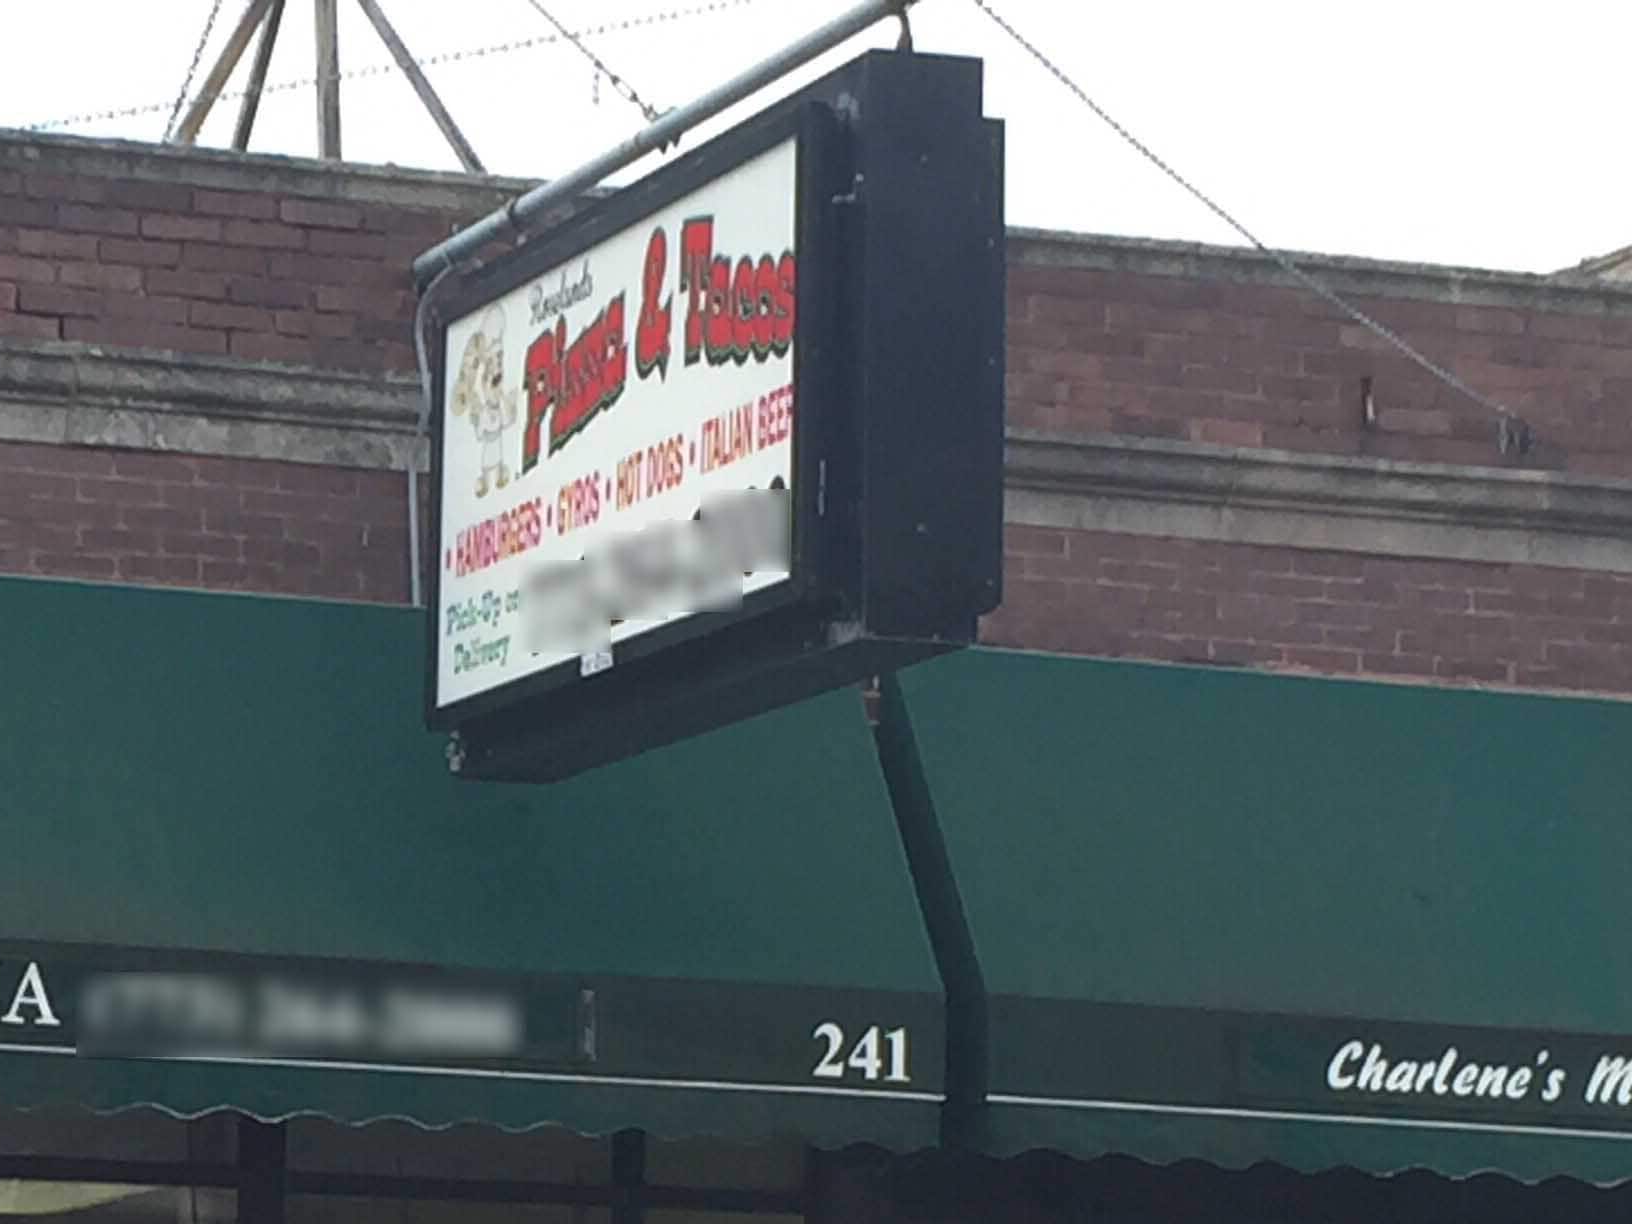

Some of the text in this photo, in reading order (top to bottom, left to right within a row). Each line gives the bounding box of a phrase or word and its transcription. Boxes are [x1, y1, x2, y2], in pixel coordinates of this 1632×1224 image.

[635, 227, 671, 383] &
[456, 384, 793, 577] HAMBURGERS GYROS HOT DOGS ITALIAN BEEF
[811, 1022, 911, 1082] 241
[1326, 1040, 1566, 1101] Charlene's
